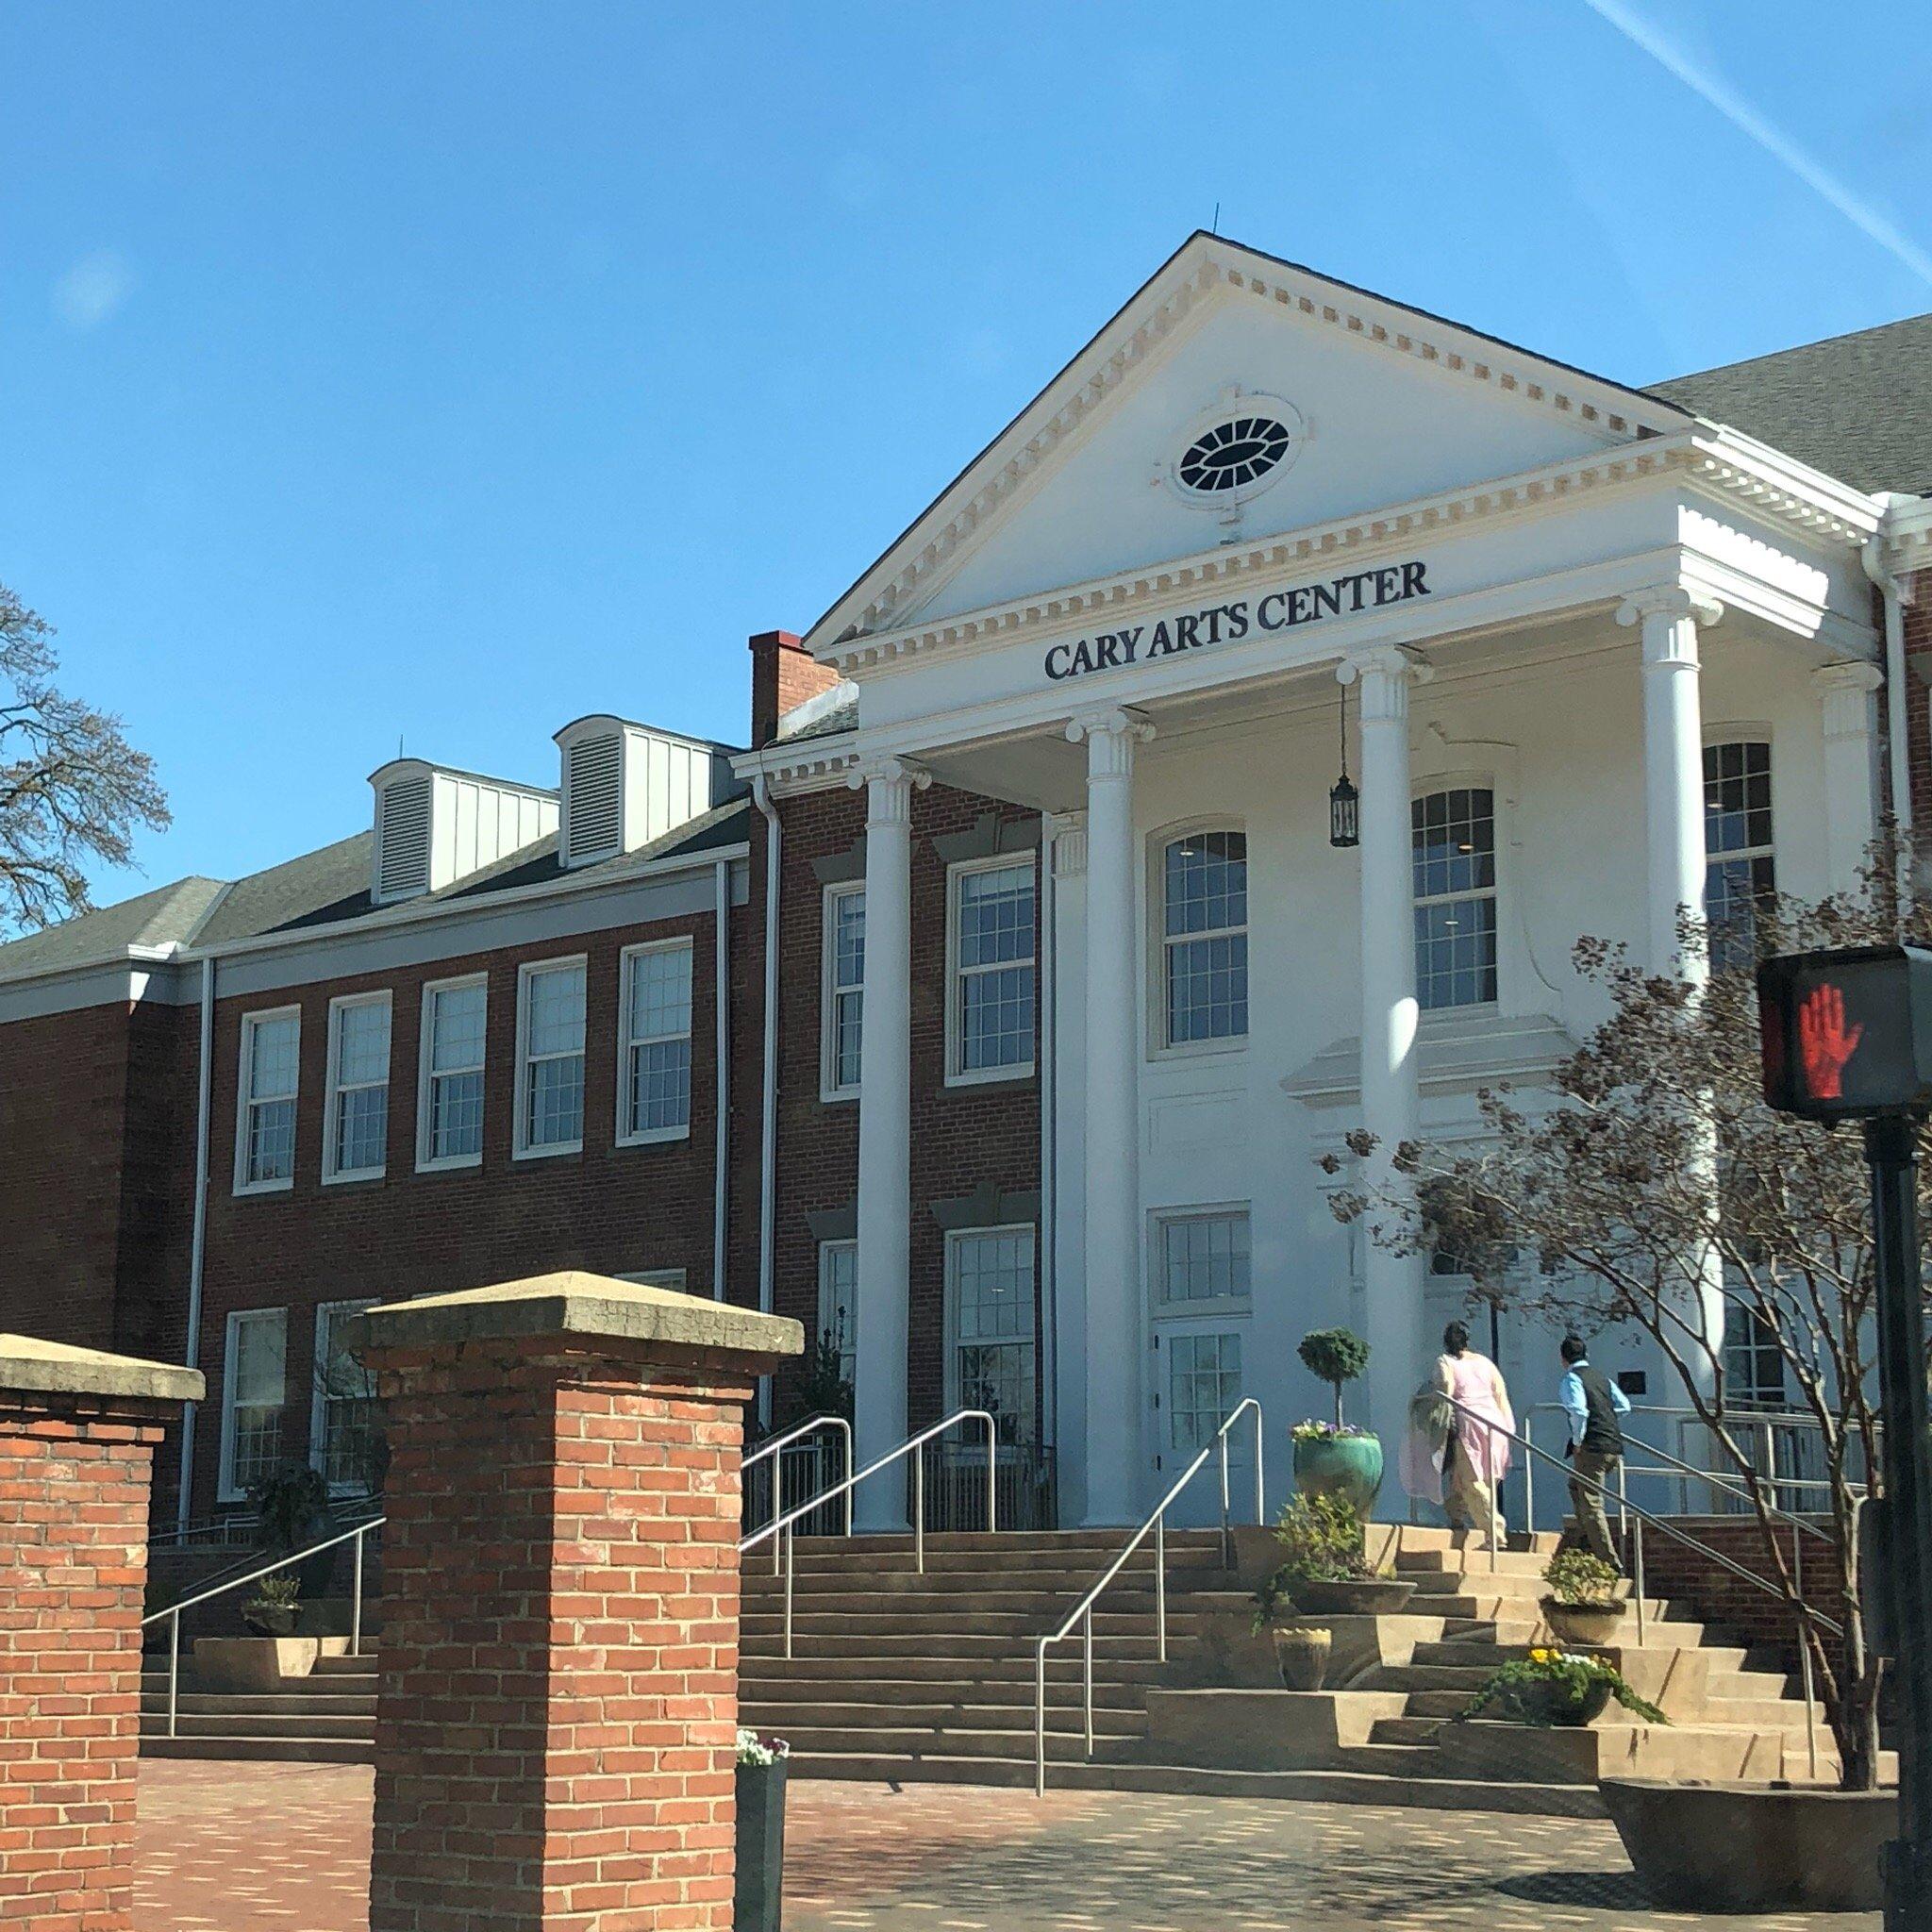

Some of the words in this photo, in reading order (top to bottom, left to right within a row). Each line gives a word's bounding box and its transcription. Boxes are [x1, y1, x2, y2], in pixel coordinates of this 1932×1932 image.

[1044, 625, 1145, 681] CARY
[1145, 601, 1249, 659] ARTS
[1257, 560, 1432, 631] CENTER
